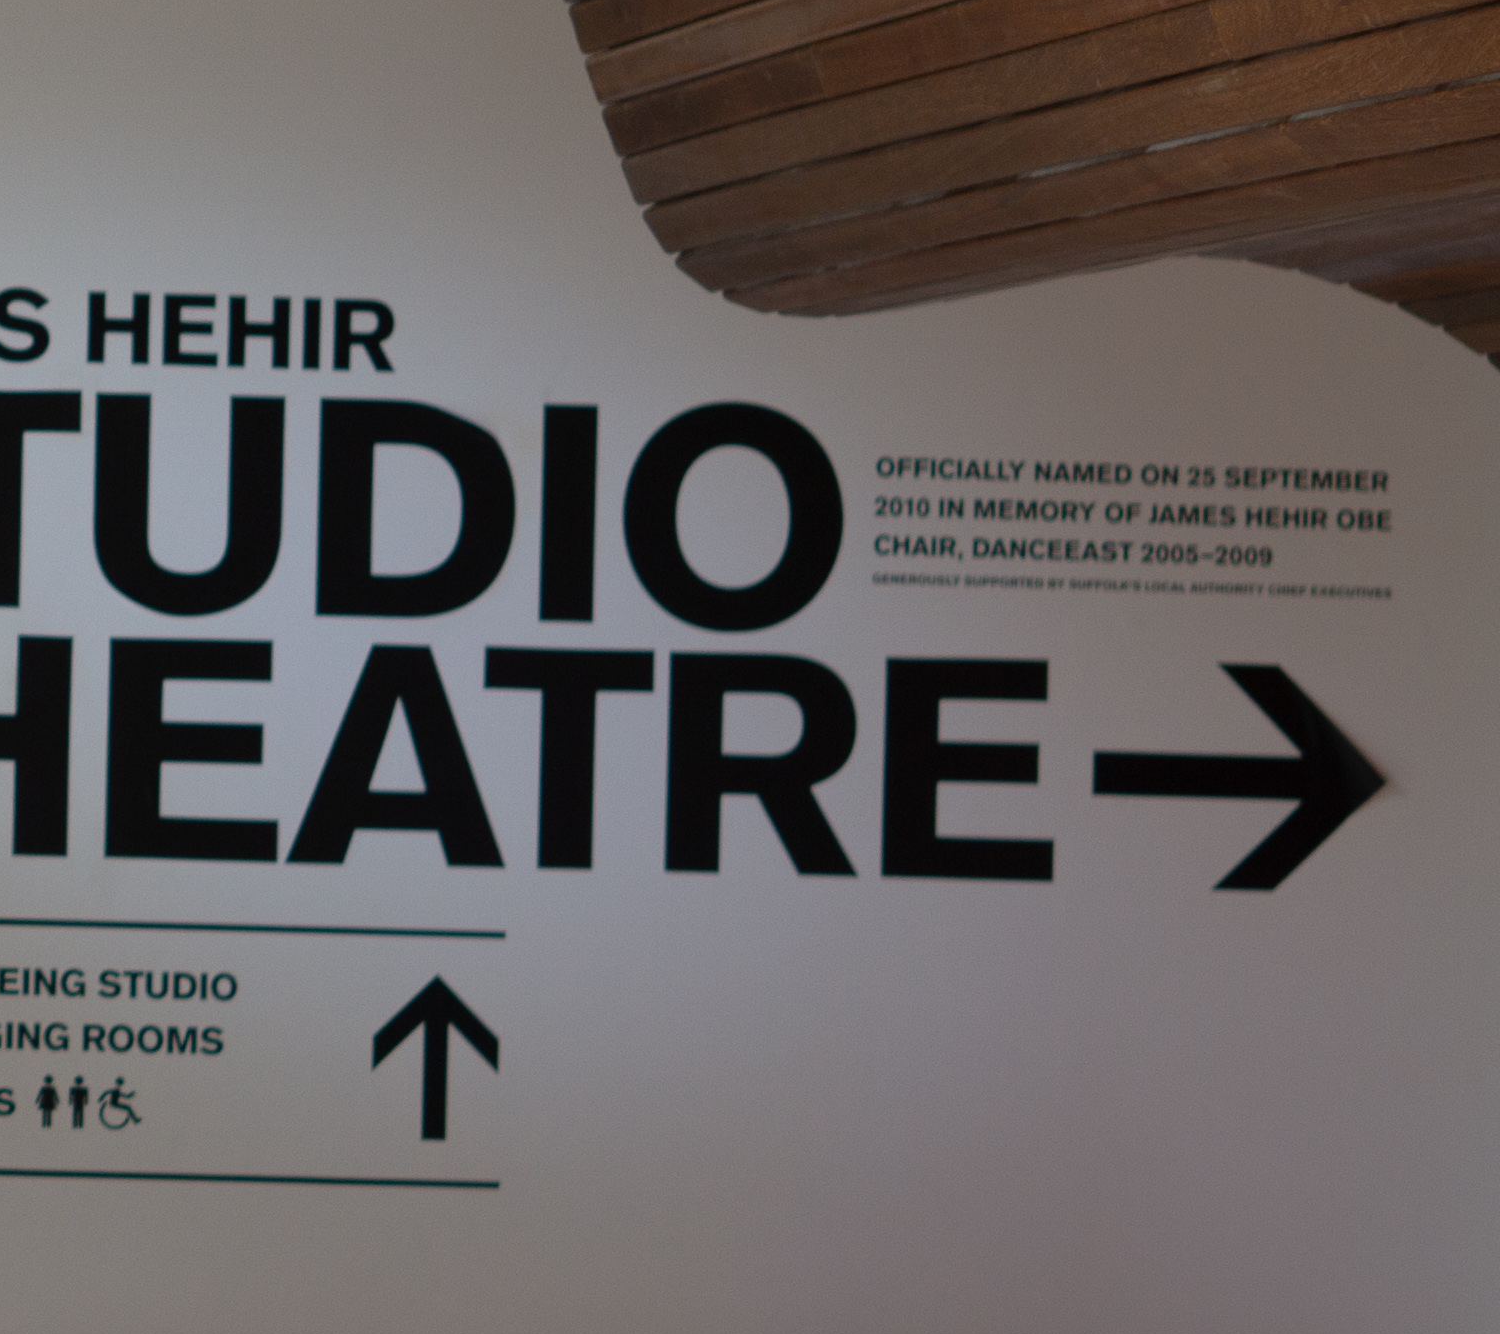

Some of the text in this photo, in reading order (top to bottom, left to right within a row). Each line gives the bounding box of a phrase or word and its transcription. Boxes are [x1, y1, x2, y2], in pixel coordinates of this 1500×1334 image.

[87, 291, 396, 373] HEHIR
[875, 456, 1389, 493] OFFICIALLY NAMED ON 25 SEPTEMBER
[875, 496, 1392, 532] 2010 IN MEMORY OF JAMES HEHIR OBE
[873, 534, 964, 561] CHAIR,
[971, 538, 1133, 563] DANCEEAST
[872, 571, 960, 587] GENEROUSLY
[964, 574, 1045, 590] SUPPORTED
[1047, 577, 1065, 591] BY
[1144, 581, 1185, 594] LOCAL
[1190, 581, 1264, 596] AUTHORITY
[1268, 583, 1307, 597] CHIEF
[1310, 584, 1393, 600] EXECUTIVES
[98, 969, 238, 1002] STUDIO
[82, 1024, 225, 1056] ROOMS
